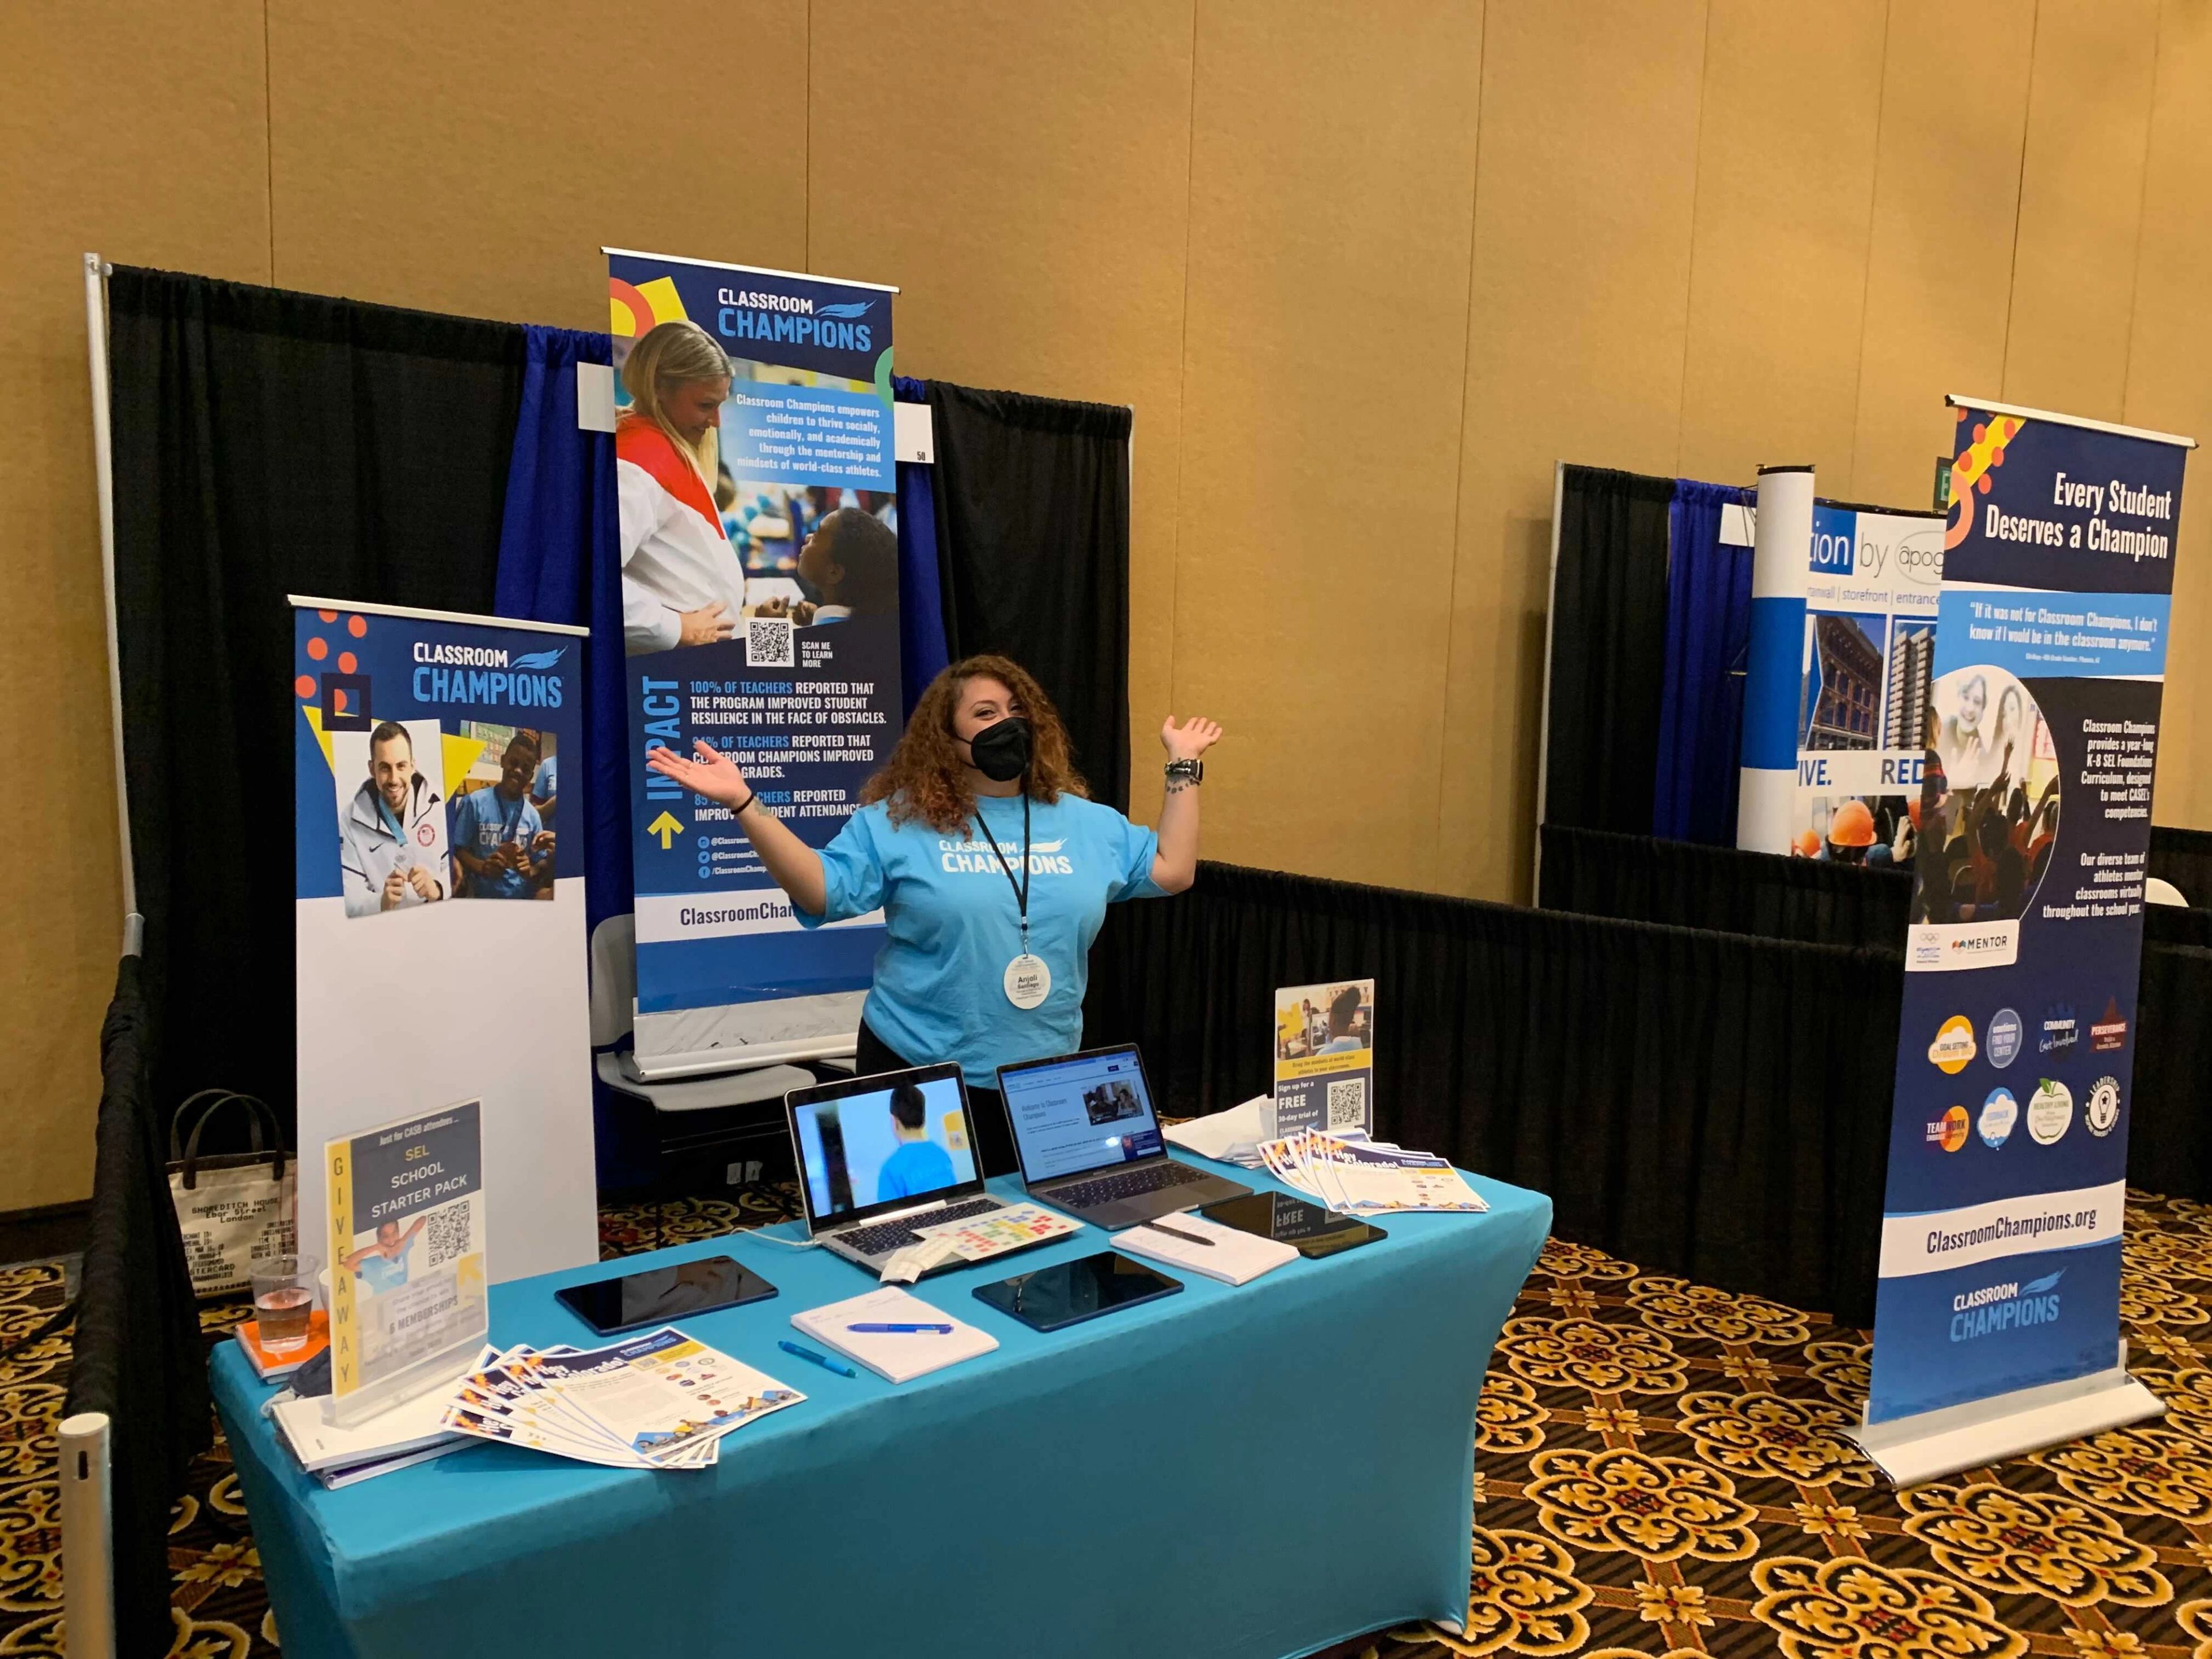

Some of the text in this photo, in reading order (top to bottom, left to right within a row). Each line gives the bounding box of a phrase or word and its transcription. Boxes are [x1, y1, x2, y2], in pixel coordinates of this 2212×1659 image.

[718, 288, 813, 314] CLASSROOM
[718, 308, 872, 352] CHAMPIONS
[736, 393, 880, 418] Classroom Champions empowers
[766, 413, 880, 434] children to thrive socially,
[749, 427, 880, 449] emotionally, and academically
[759, 442, 881, 463] through the mentorship and
[737, 457, 881, 478] mindsets of world-class athletes.
[2054, 472, 2172, 520] Every Student
[1986, 504, 2168, 562] Deserves a Champion
[1860, 532, 1889, 578] by
[1843, 589, 1888, 603] storefront
[1984, 604, 1991, 619] it
[1994, 608, 2008, 620] was
[2010, 607, 2023, 622] not
[2025, 607, 2036, 623] for
[2038, 608, 2084, 626] Classroom
[2086, 612, 2133, 632] Champions,
[2135, 616, 2138, 631] I
[1969, 623, 1993, 641] know
[1995, 626, 2002, 641] if
[2003, 626, 2007, 641] I
[2008, 628, 2030, 643] would
[2032, 630, 2042, 644] be
[2044, 630, 2052, 645] in
[2054, 631, 2070, 646] the
[2072, 632, 2116, 649] classroom
[802, 642, 820, 650] SCAN
[414, 642, 509, 668] CLASSROOM
[802, 650, 833, 659] TO LEARN
[802, 660, 821, 668] MORE
[413, 666, 563, 708] CHAMPIONS
[690, 681, 874, 694] 100% OF TEACHERS REPORTED THAT
[690, 696, 868, 709] THE PROGRAM IMPROVED STUDENT
[691, 712, 887, 724] RESILIENCE IN THE FACE OF OBSTACLES.
[2083, 719, 2155, 736] Classroom Champions
[721, 734, 871, 748] OF TEACHERS REPORTED THAT
[2088, 737, 2119, 752] provides
[2121, 741, 2126, 750] a
[758, 749, 873, 763] CHAMPIONS IMPROVED
[2087, 753, 2101, 767] K-8
[2103, 754, 2116, 767] SEL
[741, 766, 785, 778] GRADES.
[2081, 771, 2152, 787] Curriculum, designed
[794, 790, 846, 802] REPORTED
[2100, 789, 2128, 801] to meet
[2081, 853, 2096, 866] Our
[2097, 853, 2123, 866] diverse
[2124, 853, 2139, 865] team
[2093, 869, 2123, 882] athletes
[2075, 887, 2119, 900] classrooms
[2043, 904, 2089, 920] throughout
[2091, 903, 2104, 916] the
[2105, 902, 2128, 915] school
[1967, 935, 2007, 949] MENTOR
[2044, 1019, 2075, 1031] COMMUNITY
[1278, 1085, 1291, 1093] Sign
[1279, 1094, 1306, 1110] FREE
[1278, 1113, 1298, 1123] 30-day
[1298, 1111, 1311, 1119] trial
[405, 1145, 430, 1161] SEL
[391, 1162, 445, 1188] SCHOOL
[372, 1175, 467, 1218] STARTER PACK
[220, 1214, 253, 1224] London
[1926, 1208, 2097, 1254] ClassroomChampions.org
[1953, 1282, 2018, 1312] CLASSROOM
[397, 1295, 459, 1331] MEMBERSHIPS
[1950, 1294, 2060, 1343] CHAMPIONS
